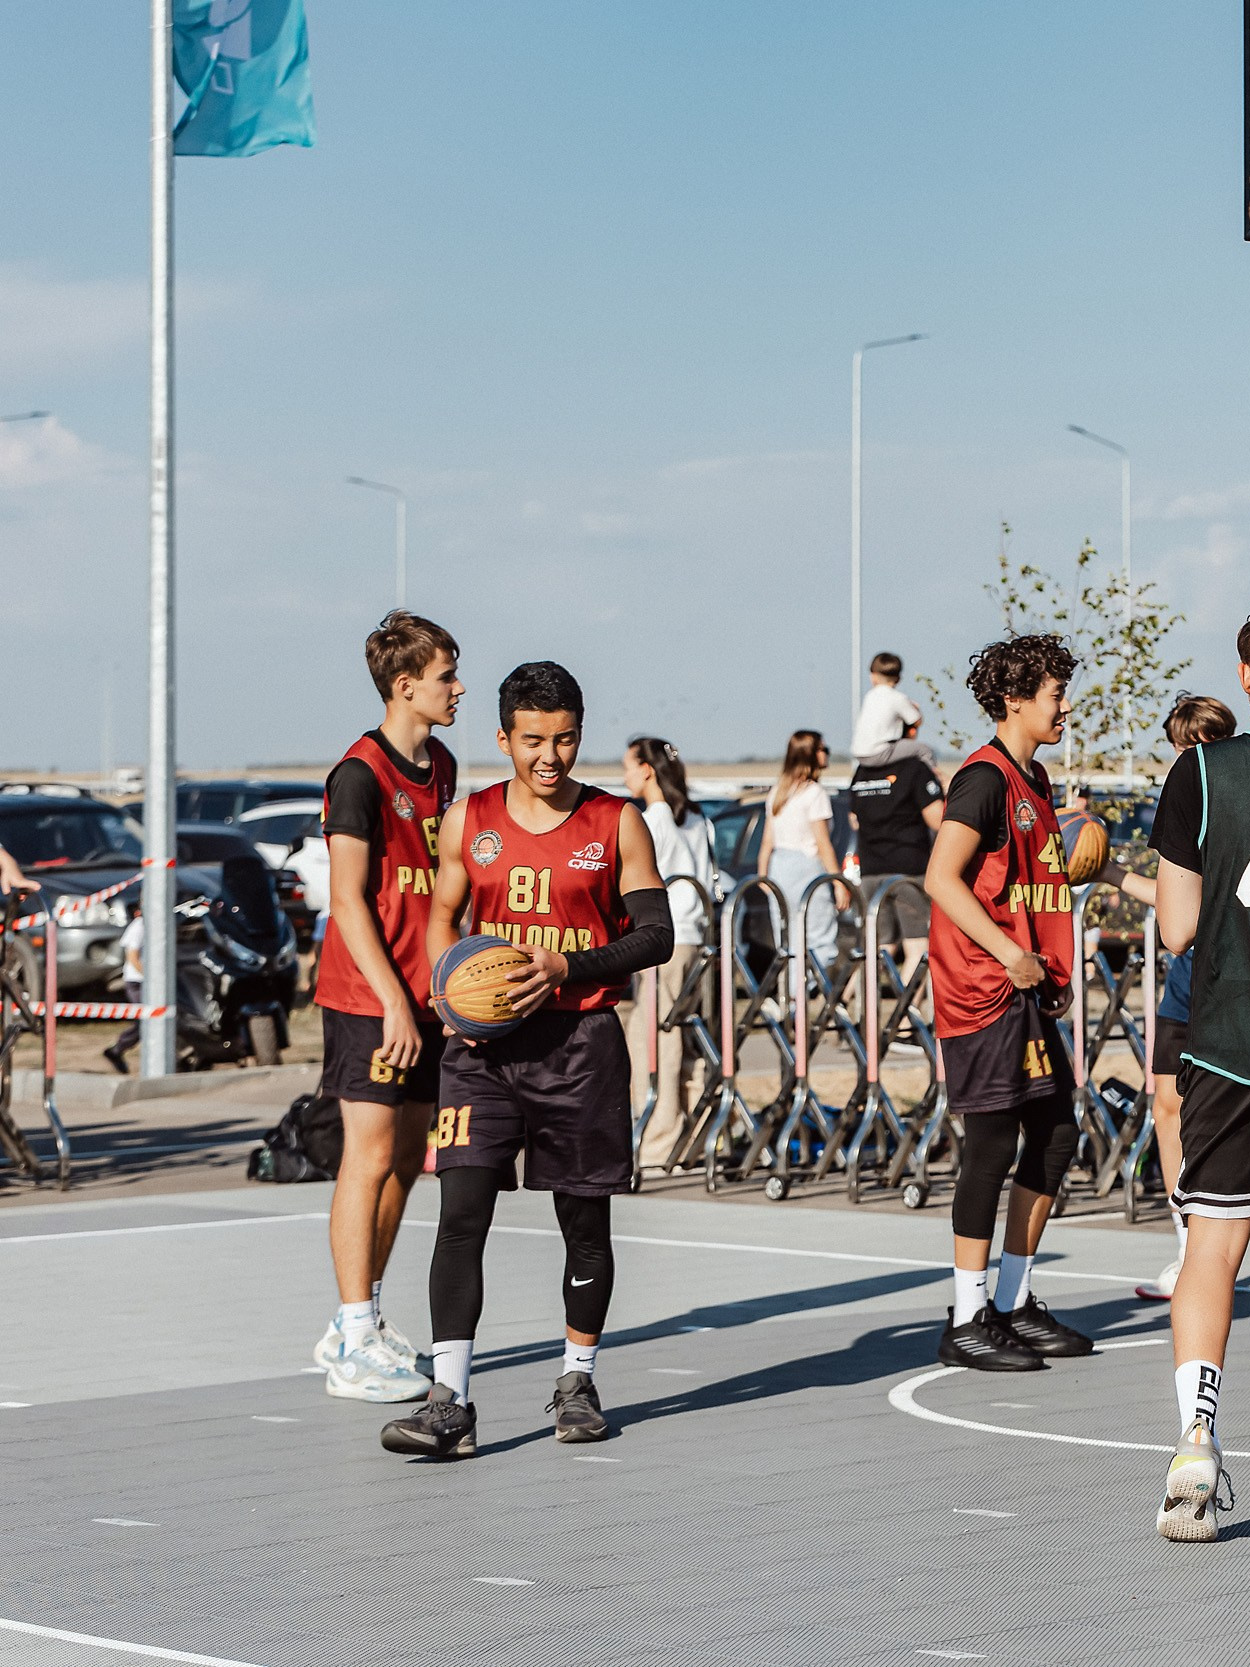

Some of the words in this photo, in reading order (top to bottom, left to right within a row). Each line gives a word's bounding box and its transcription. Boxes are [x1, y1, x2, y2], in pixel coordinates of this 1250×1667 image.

[422, 816, 441, 856] 6
[567, 858, 609, 872] QBF
[507, 866, 552, 914] 81
[438, 1105, 472, 1150] 81
